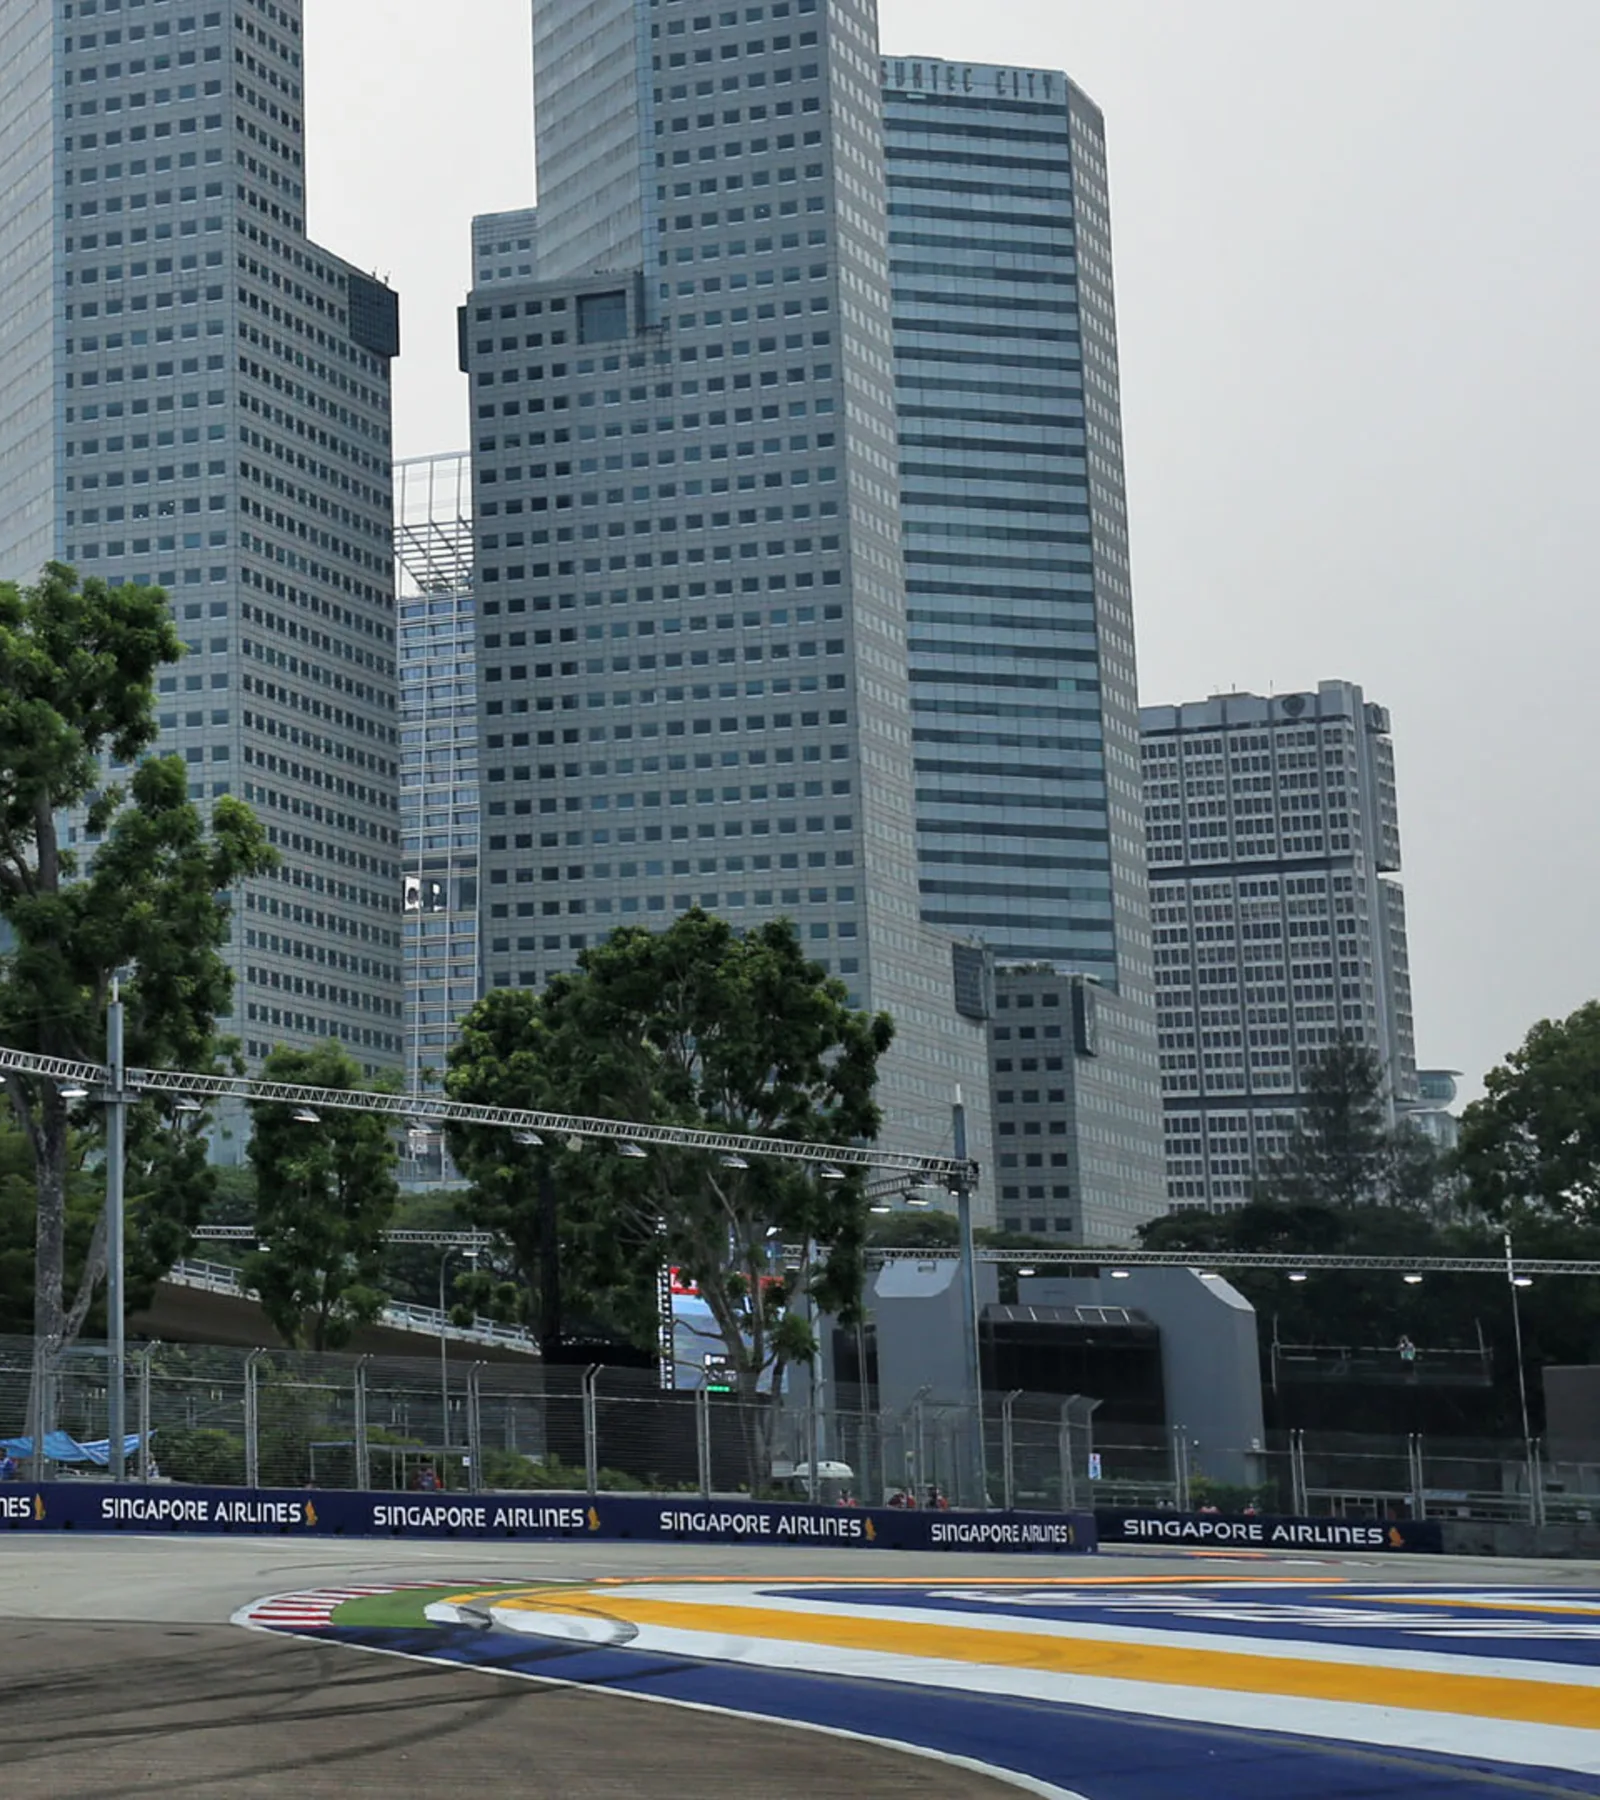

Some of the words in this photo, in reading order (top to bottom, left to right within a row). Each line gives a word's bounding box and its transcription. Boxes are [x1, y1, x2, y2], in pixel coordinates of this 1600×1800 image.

[995, 70, 1053, 99] CITY
[102, 1498, 208, 1521] SINGAPORE
[215, 1501, 301, 1523] AIRLINES
[373, 1505, 486, 1527] SINGAPORE
[494, 1508, 584, 1528] AIRLINES
[661, 1511, 771, 1533] SINGAPORE
[778, 1516, 861, 1537] AIRLINES
[931, 1524, 1020, 1543] SINGAPORE
[1021, 1525, 1067, 1543] AIRLINES
[1124, 1519, 1263, 1540] SINGAPORE
[1273, 1526, 1383, 1545] AIRLINES
